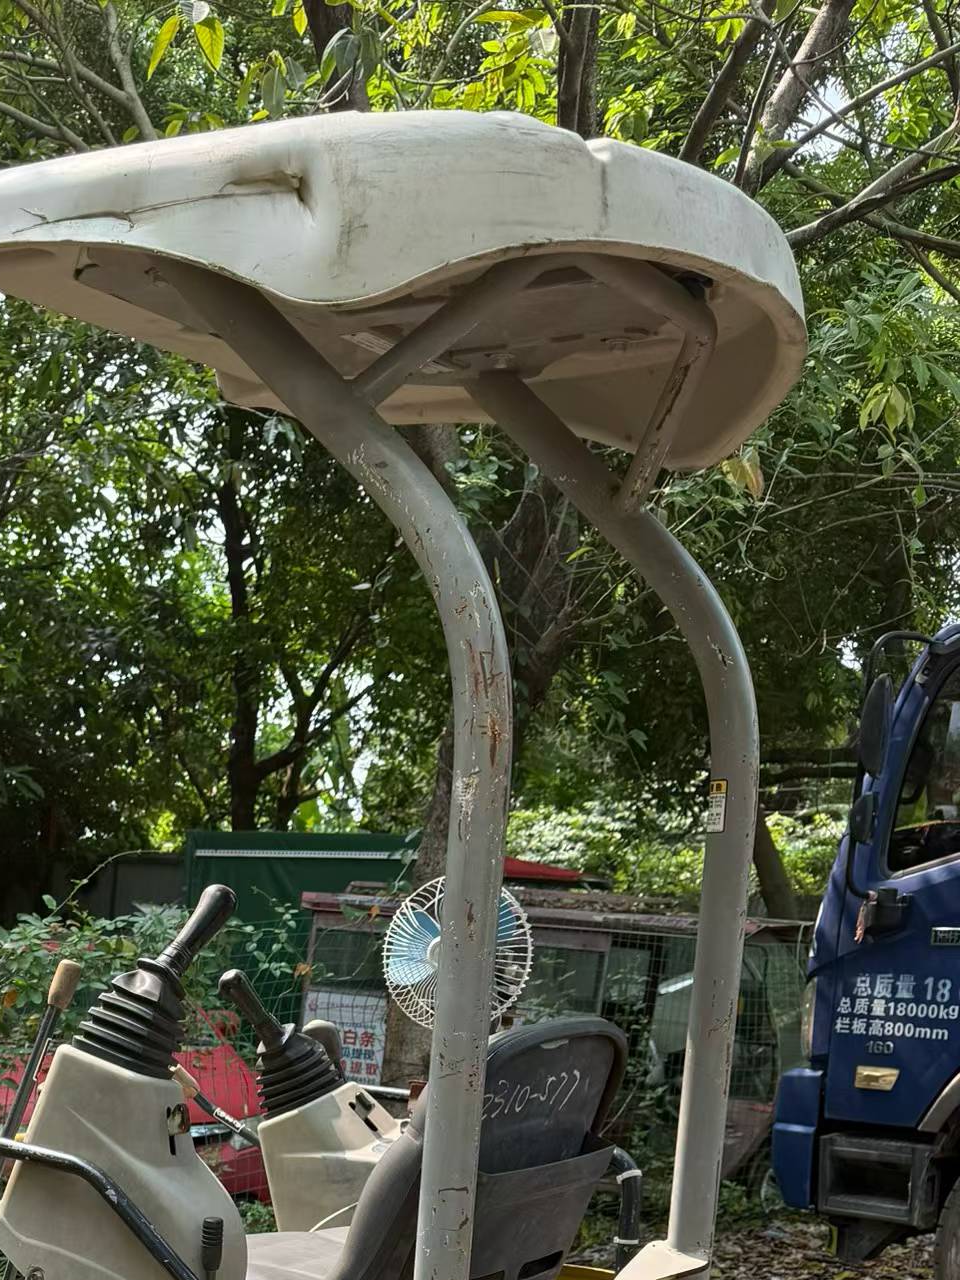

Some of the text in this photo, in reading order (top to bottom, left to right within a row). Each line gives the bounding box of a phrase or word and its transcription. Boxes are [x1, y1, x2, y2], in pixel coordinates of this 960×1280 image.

[853, 972, 916, 999] 总质量
[836, 996, 959, 1020] 总质量18000kg
[835, 1016, 949, 1040] 栏板高800mm
